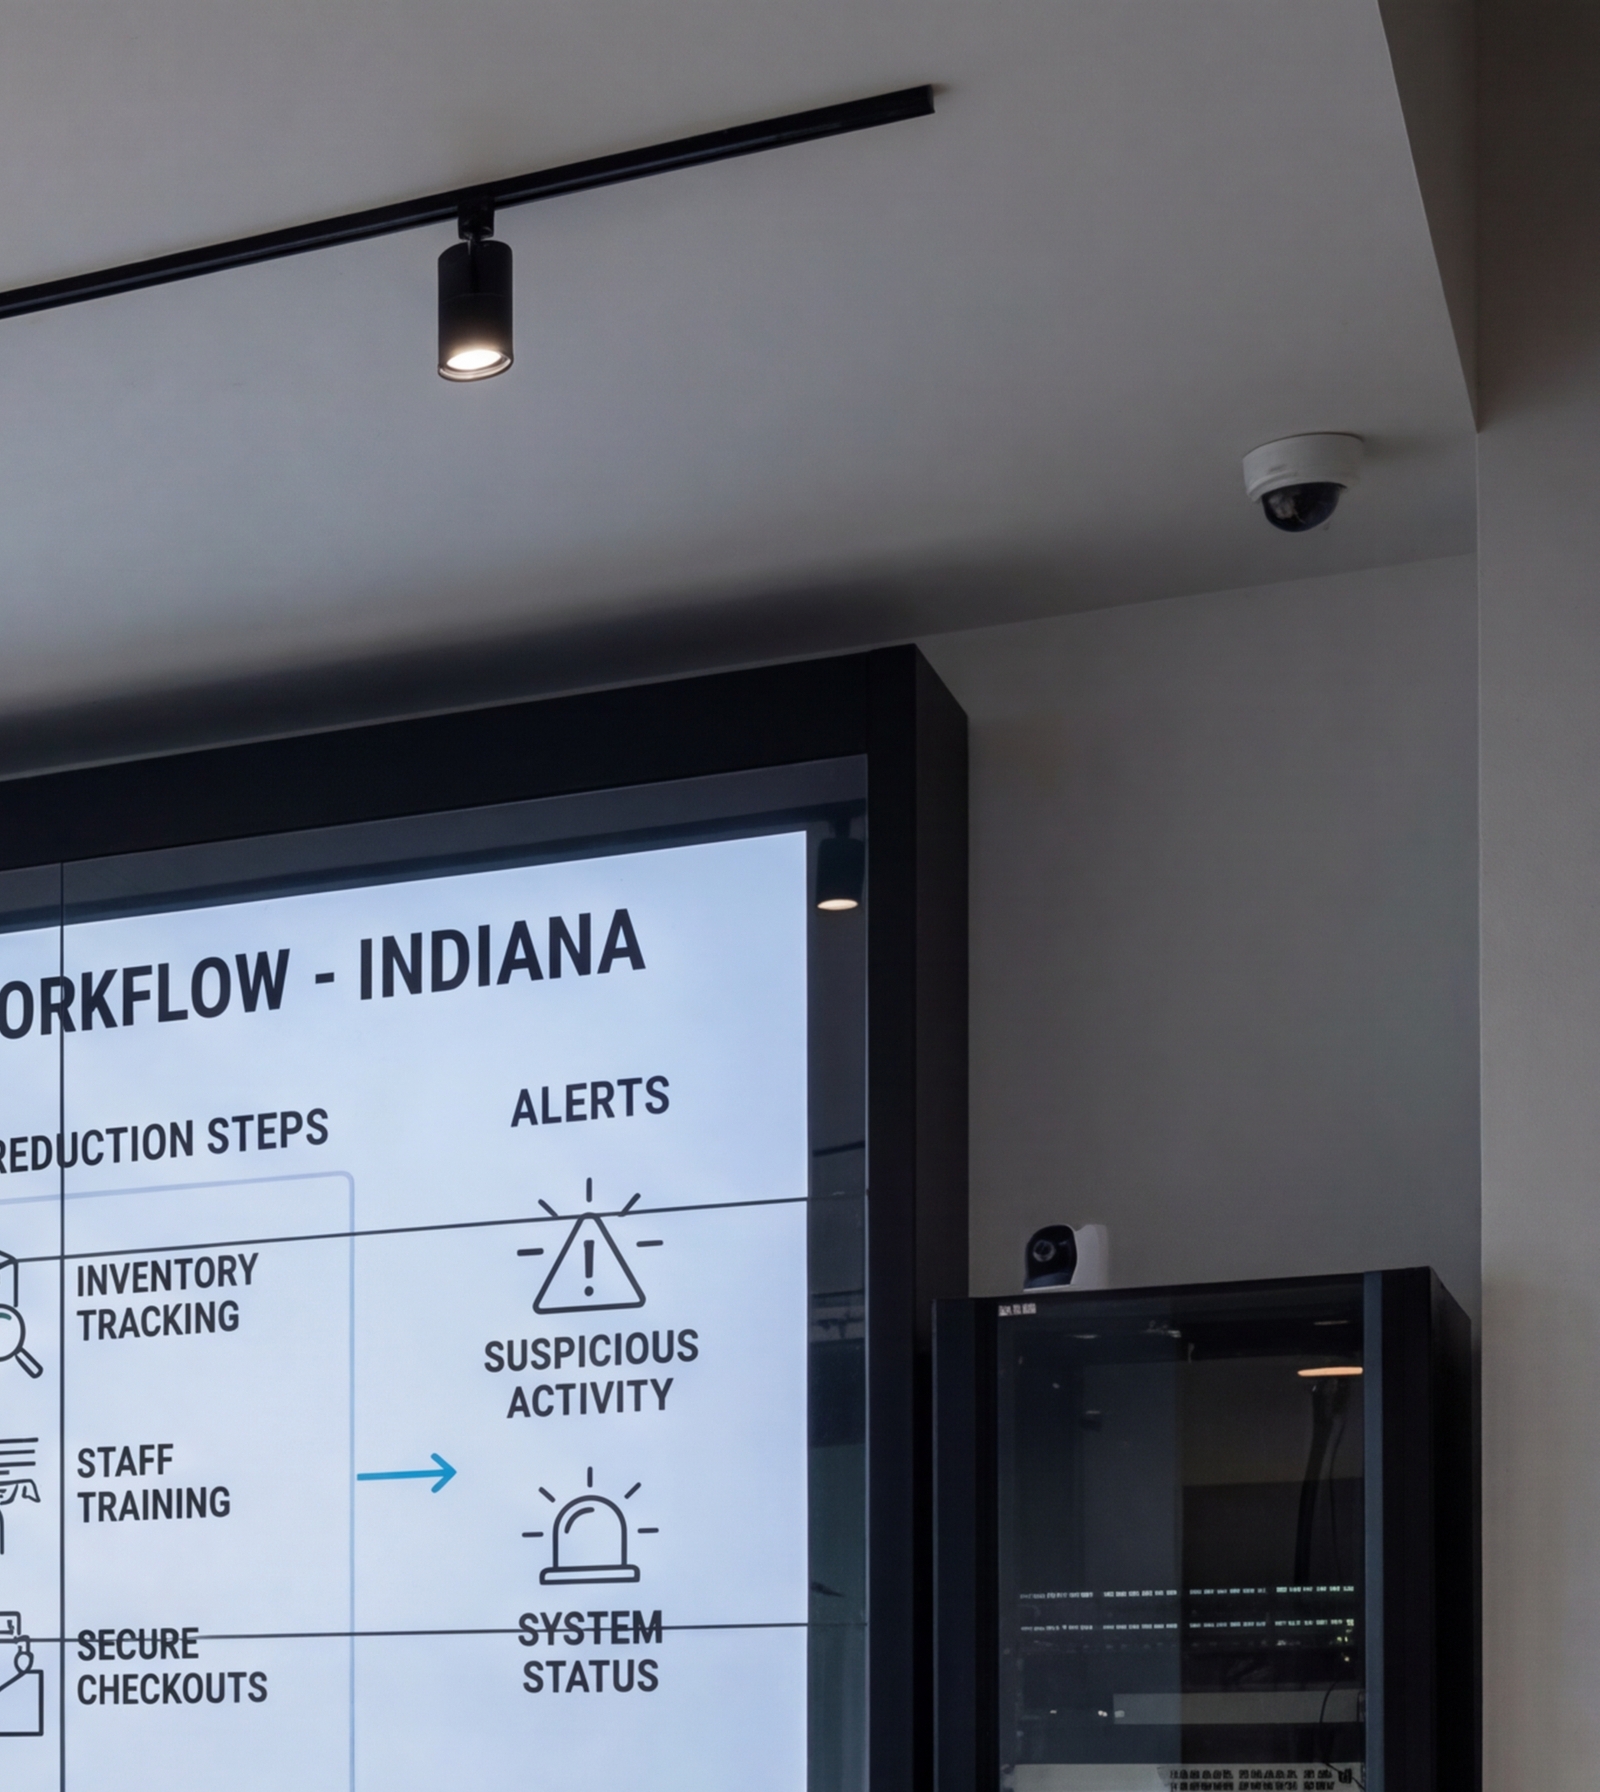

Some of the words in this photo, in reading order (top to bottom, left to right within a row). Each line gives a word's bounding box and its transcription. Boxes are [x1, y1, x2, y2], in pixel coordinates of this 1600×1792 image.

[315, 972, 335, 985] -
[360, 908, 646, 1001] INDIANA
[510, 1075, 670, 1128] ALERTS
[207, 1108, 329, 1155] STEPS
[77, 1253, 258, 1297] INVENTORY
[76, 1299, 239, 1341] TRACKING
[484, 1328, 699, 1373] SUSPICIOUS
[506, 1377, 674, 1419] ACTIVITY
[77, 1443, 174, 1479] STAFF
[77, 1486, 230, 1523] TRAINING
[77, 1627, 199, 1662] SECURE
[518, 1609, 664, 1647] SYSTEM
[77, 1671, 268, 1705] CHECKOUTS
[523, 1658, 659, 1694] STATUS
